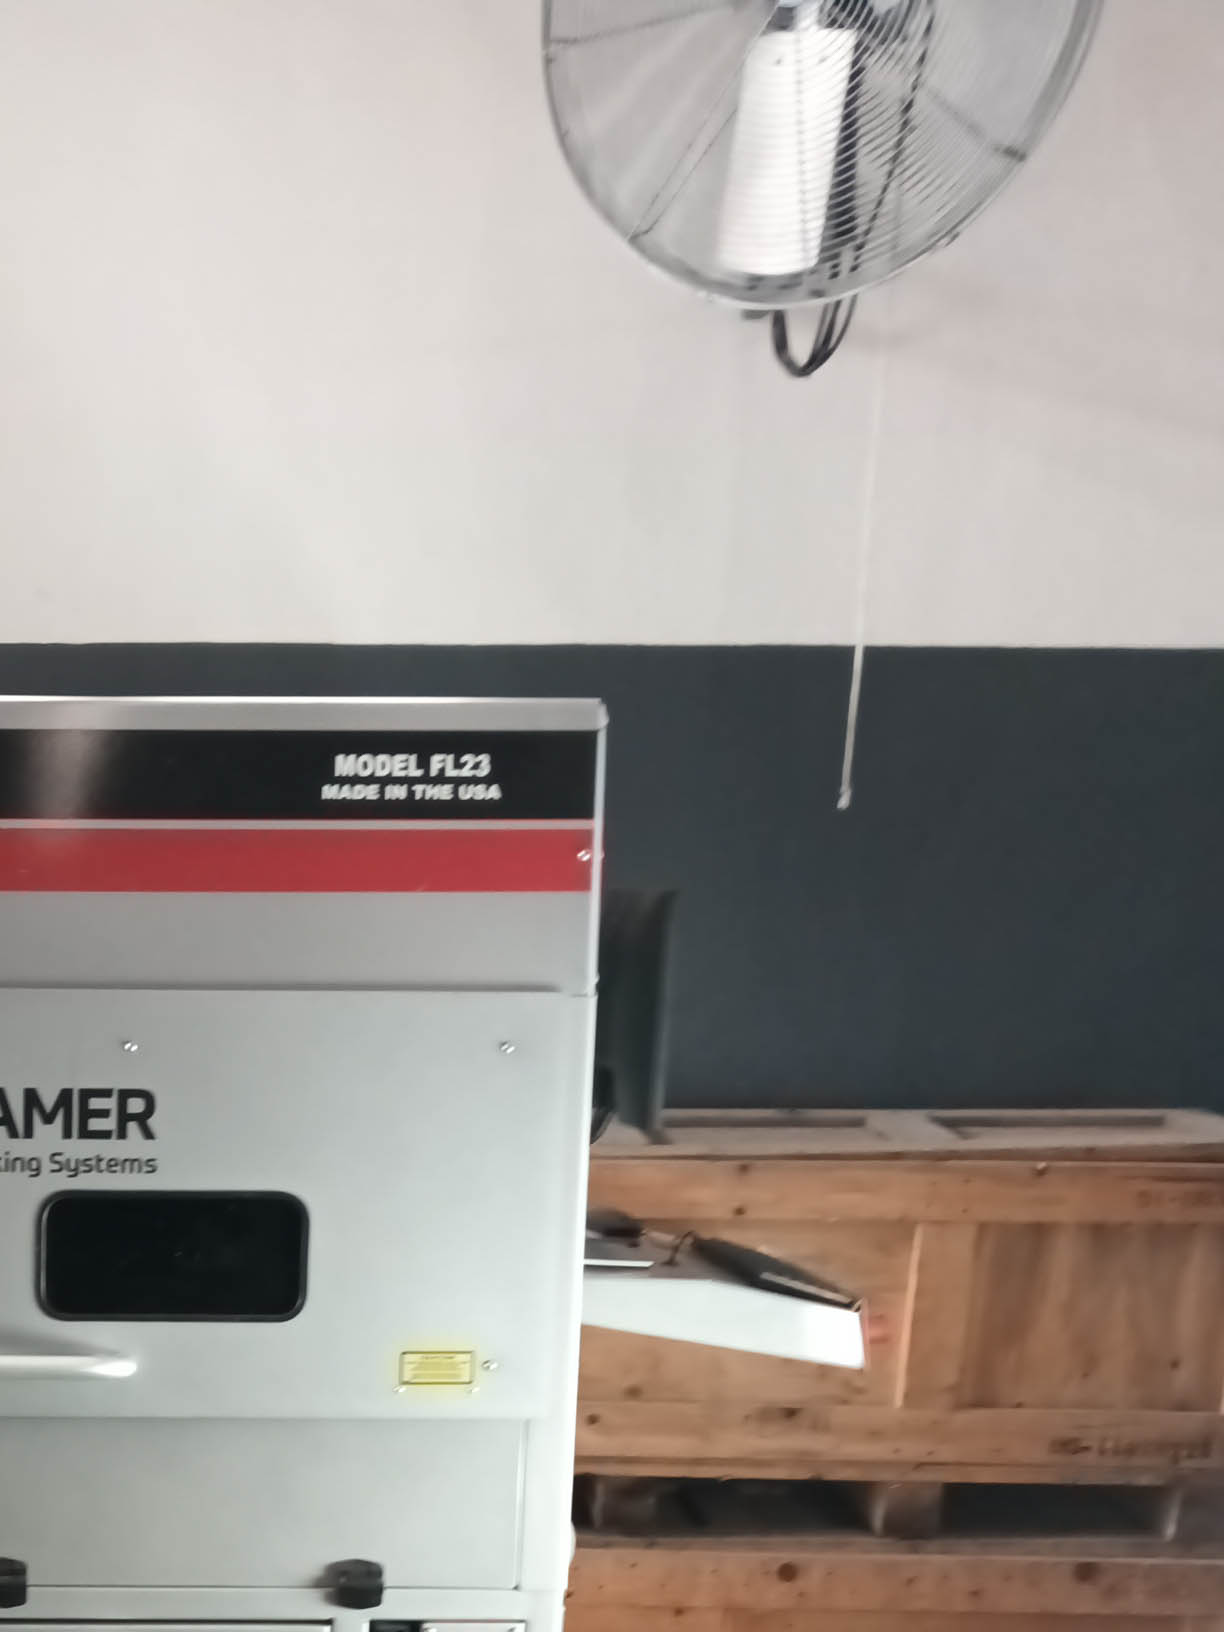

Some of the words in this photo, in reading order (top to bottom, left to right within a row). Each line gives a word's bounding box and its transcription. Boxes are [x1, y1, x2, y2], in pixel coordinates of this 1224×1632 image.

[334, 753, 425, 777] MODEL
[429, 753, 492, 777] FL23
[321, 783, 381, 800] MADE
[384, 783, 409, 800] IN
[411, 783, 455, 800] THE
[458, 783, 503, 800] USA
[49, 1152, 158, 1177] Systems
